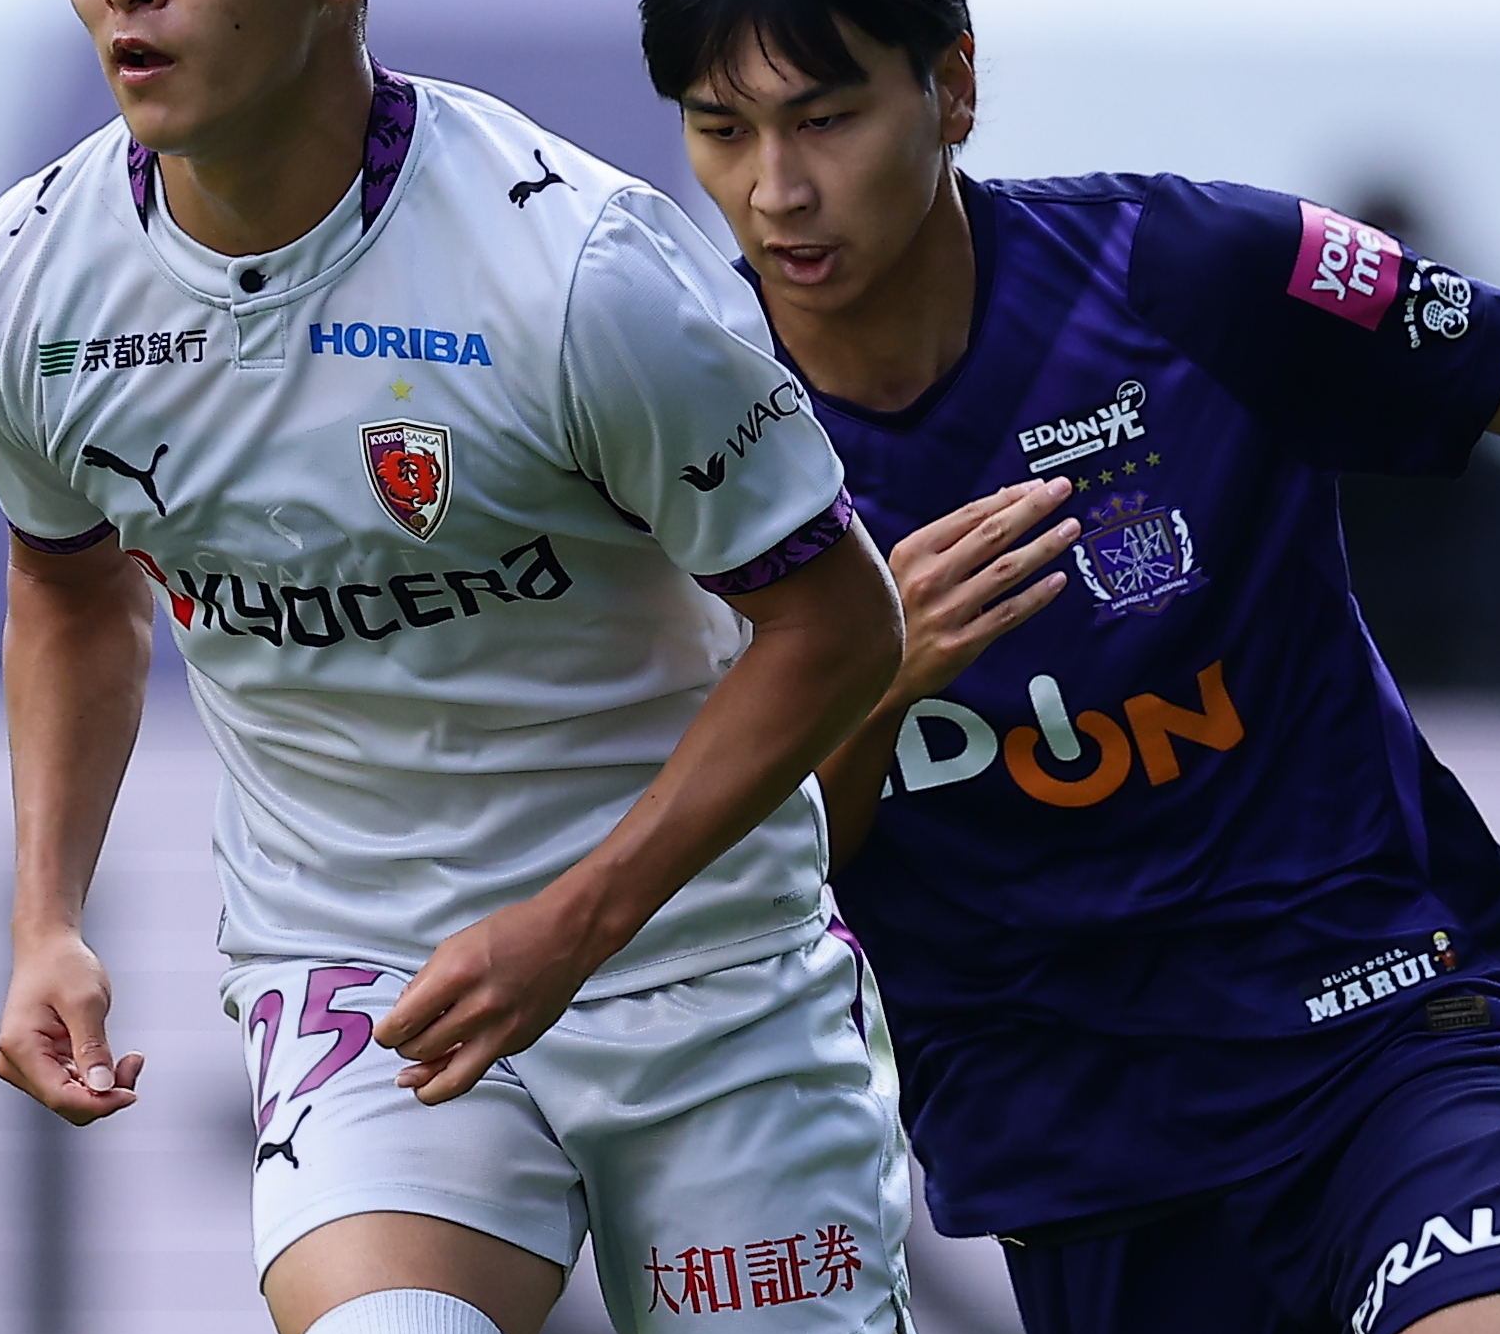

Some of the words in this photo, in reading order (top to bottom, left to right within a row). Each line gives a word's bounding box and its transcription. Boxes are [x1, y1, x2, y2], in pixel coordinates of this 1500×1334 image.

[1311, 217, 1351, 301] you
[1348, 229, 1383, 297] me
[81, 328, 208, 372] 京都銀行
[309, 322, 492, 367] HORIBA
[369, 431, 403, 446] KYOTO
[405, 432, 440, 447] SANGA
[176, 534, 574, 648] KYOCERA
[880, 659, 1245, 808] DION
[1305, 953, 1437, 1023] MARUI
[249, 965, 384, 1142] 25
[644, 1224, 862, 1315] 大和証券
